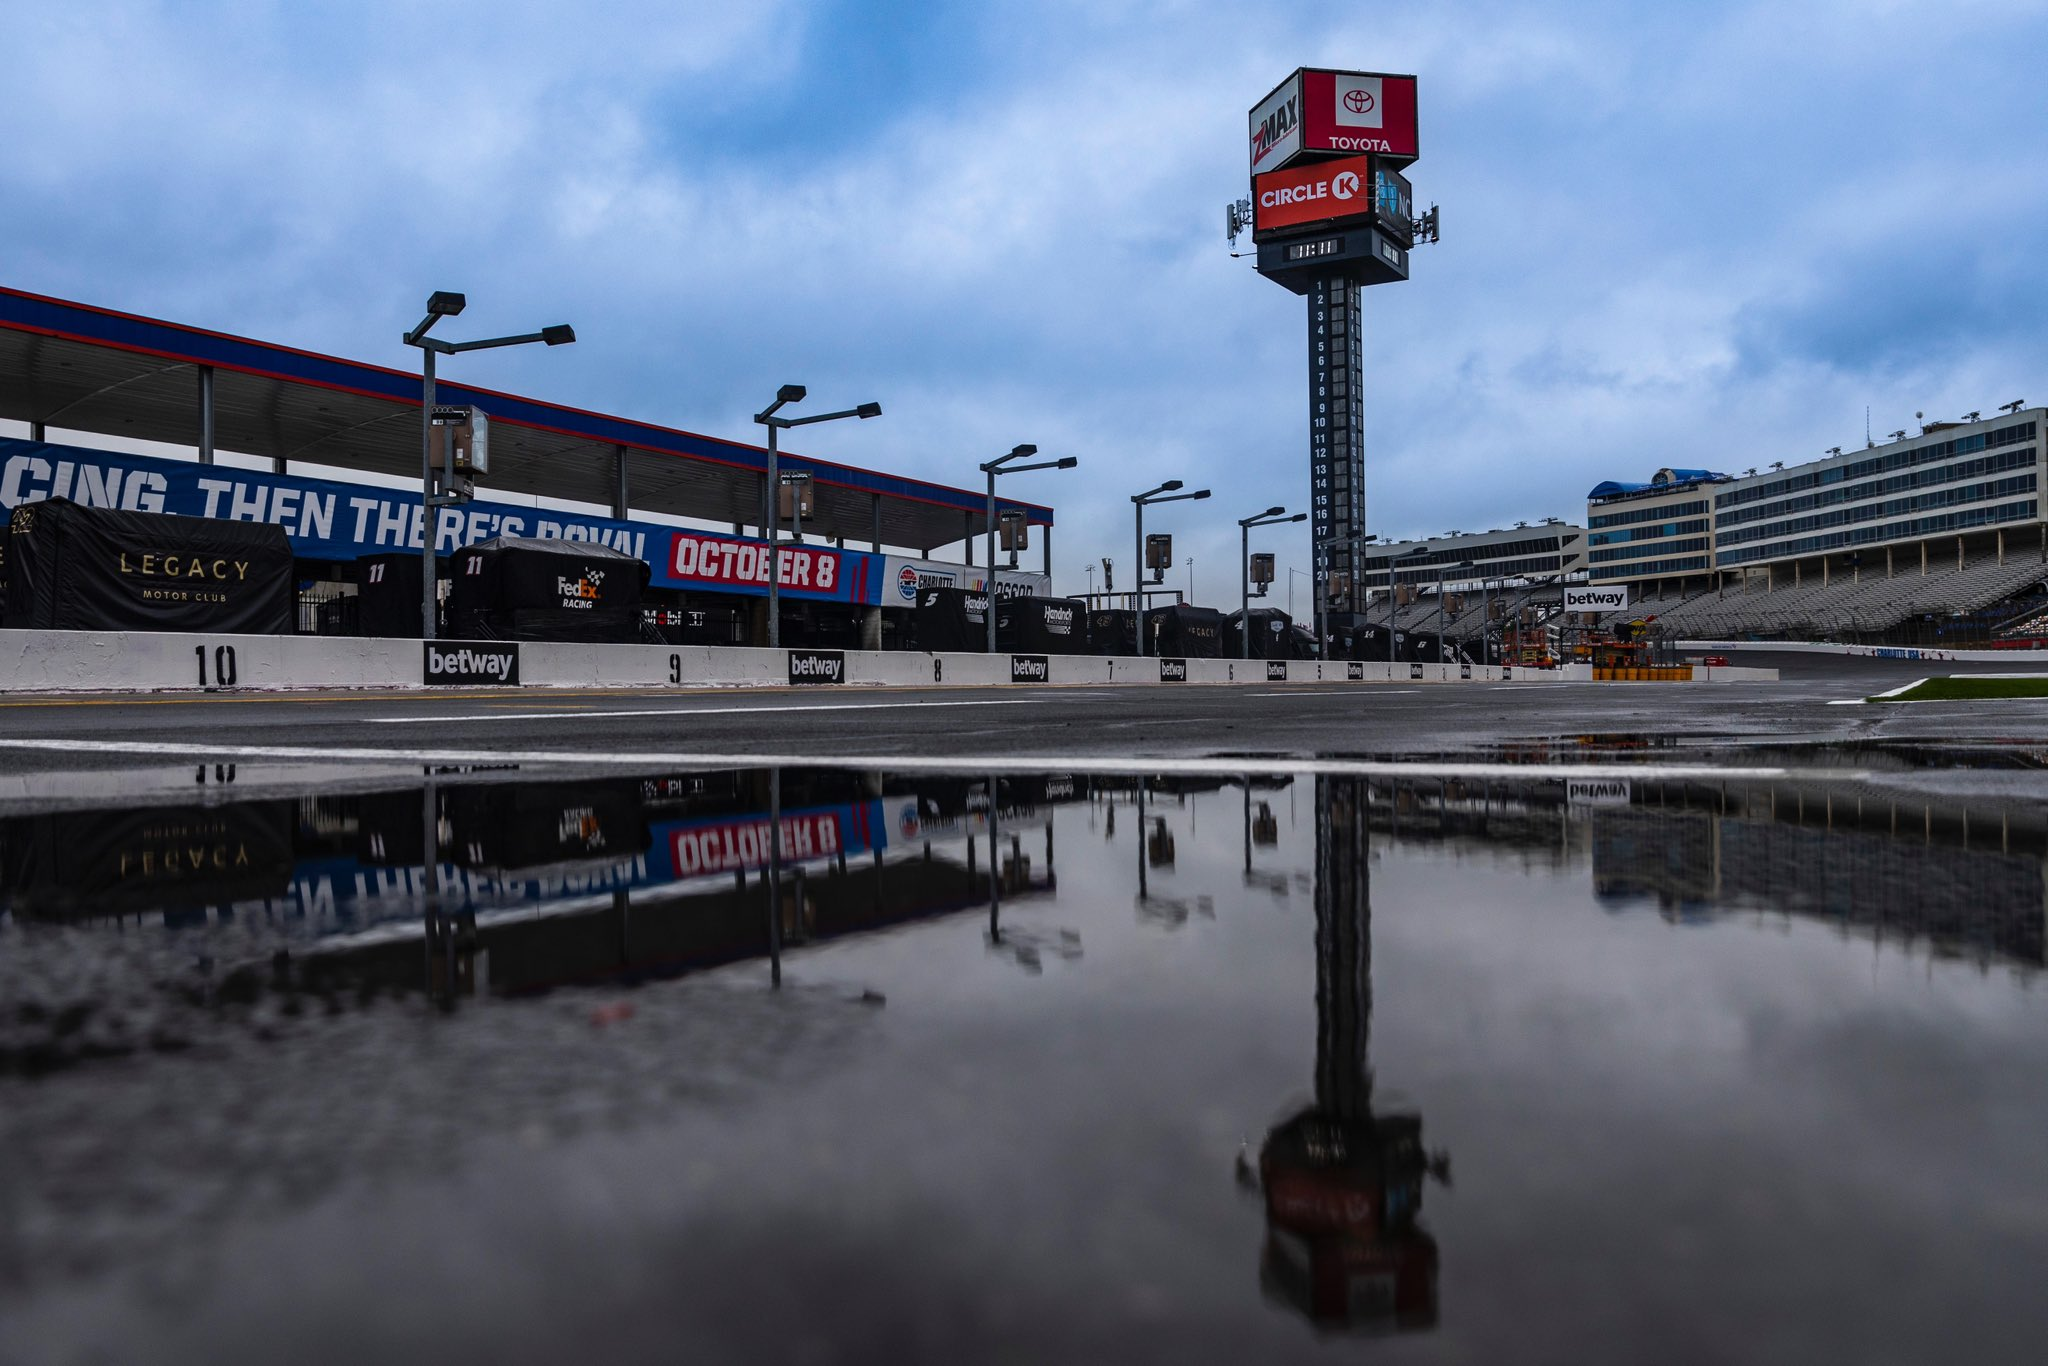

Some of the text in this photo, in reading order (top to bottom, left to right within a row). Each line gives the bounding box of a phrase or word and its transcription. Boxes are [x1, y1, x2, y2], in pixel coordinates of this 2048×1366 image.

[1329, 136, 1391, 152] TOYOTA
[1260, 181, 1327, 208] CIRCLE
[1316, 281, 1322, 290] 1
[1317, 295, 1324, 304] 2
[1318, 312, 1324, 321] 3
[1317, 325, 1324, 334] 4
[1318, 342, 1324, 351] 5
[1318, 356, 1324, 366] 6
[1319, 373, 1324, 382] 7
[1319, 387, 1325, 396] 8
[1319, 403, 1325, 413] 9
[1314, 418, 1326, 427] 10
[1315, 434, 1325, 444] 11
[1315, 448, 1326, 458] 12
[1315, 465, 1327, 474] 13
[1316, 479, 1327, 488] 14
[1316, 496, 1327, 505] 15
[1316, 509, 1327, 519] 16
[0, 455, 176, 515] CING
[198, 478, 336, 540] THEN
[676, 538, 811, 586] OCTOBER
[816, 555, 836, 588] 8
[1316, 526, 1328, 536] 17
[120, 552, 248, 580] LEGACY
[466, 556, 482, 575] 11
[369, 563, 385, 583] 11
[558, 576, 597, 600] FedEx
[918, 574, 953, 589] CHARLOTTE
[143, 590, 226, 602] MOTOR CLUB
[925, 592, 938, 607] 5
[1568, 593, 1624, 607] betway
[562, 599, 592, 609] RACING
[964, 594, 989, 613] Hendric
[195, 645, 237, 686] 10
[428, 647, 513, 680] betway
[669, 653, 681, 683] 9
[792, 655, 841, 680] betway
[934, 659, 941, 682] 8
[1014, 659, 1046, 679] betway
[1108, 660, 1113, 680] 7
[1162, 662, 1185, 679] betway
[1229, 664, 1234, 680] 6
[1268, 664, 1286, 678] betway
